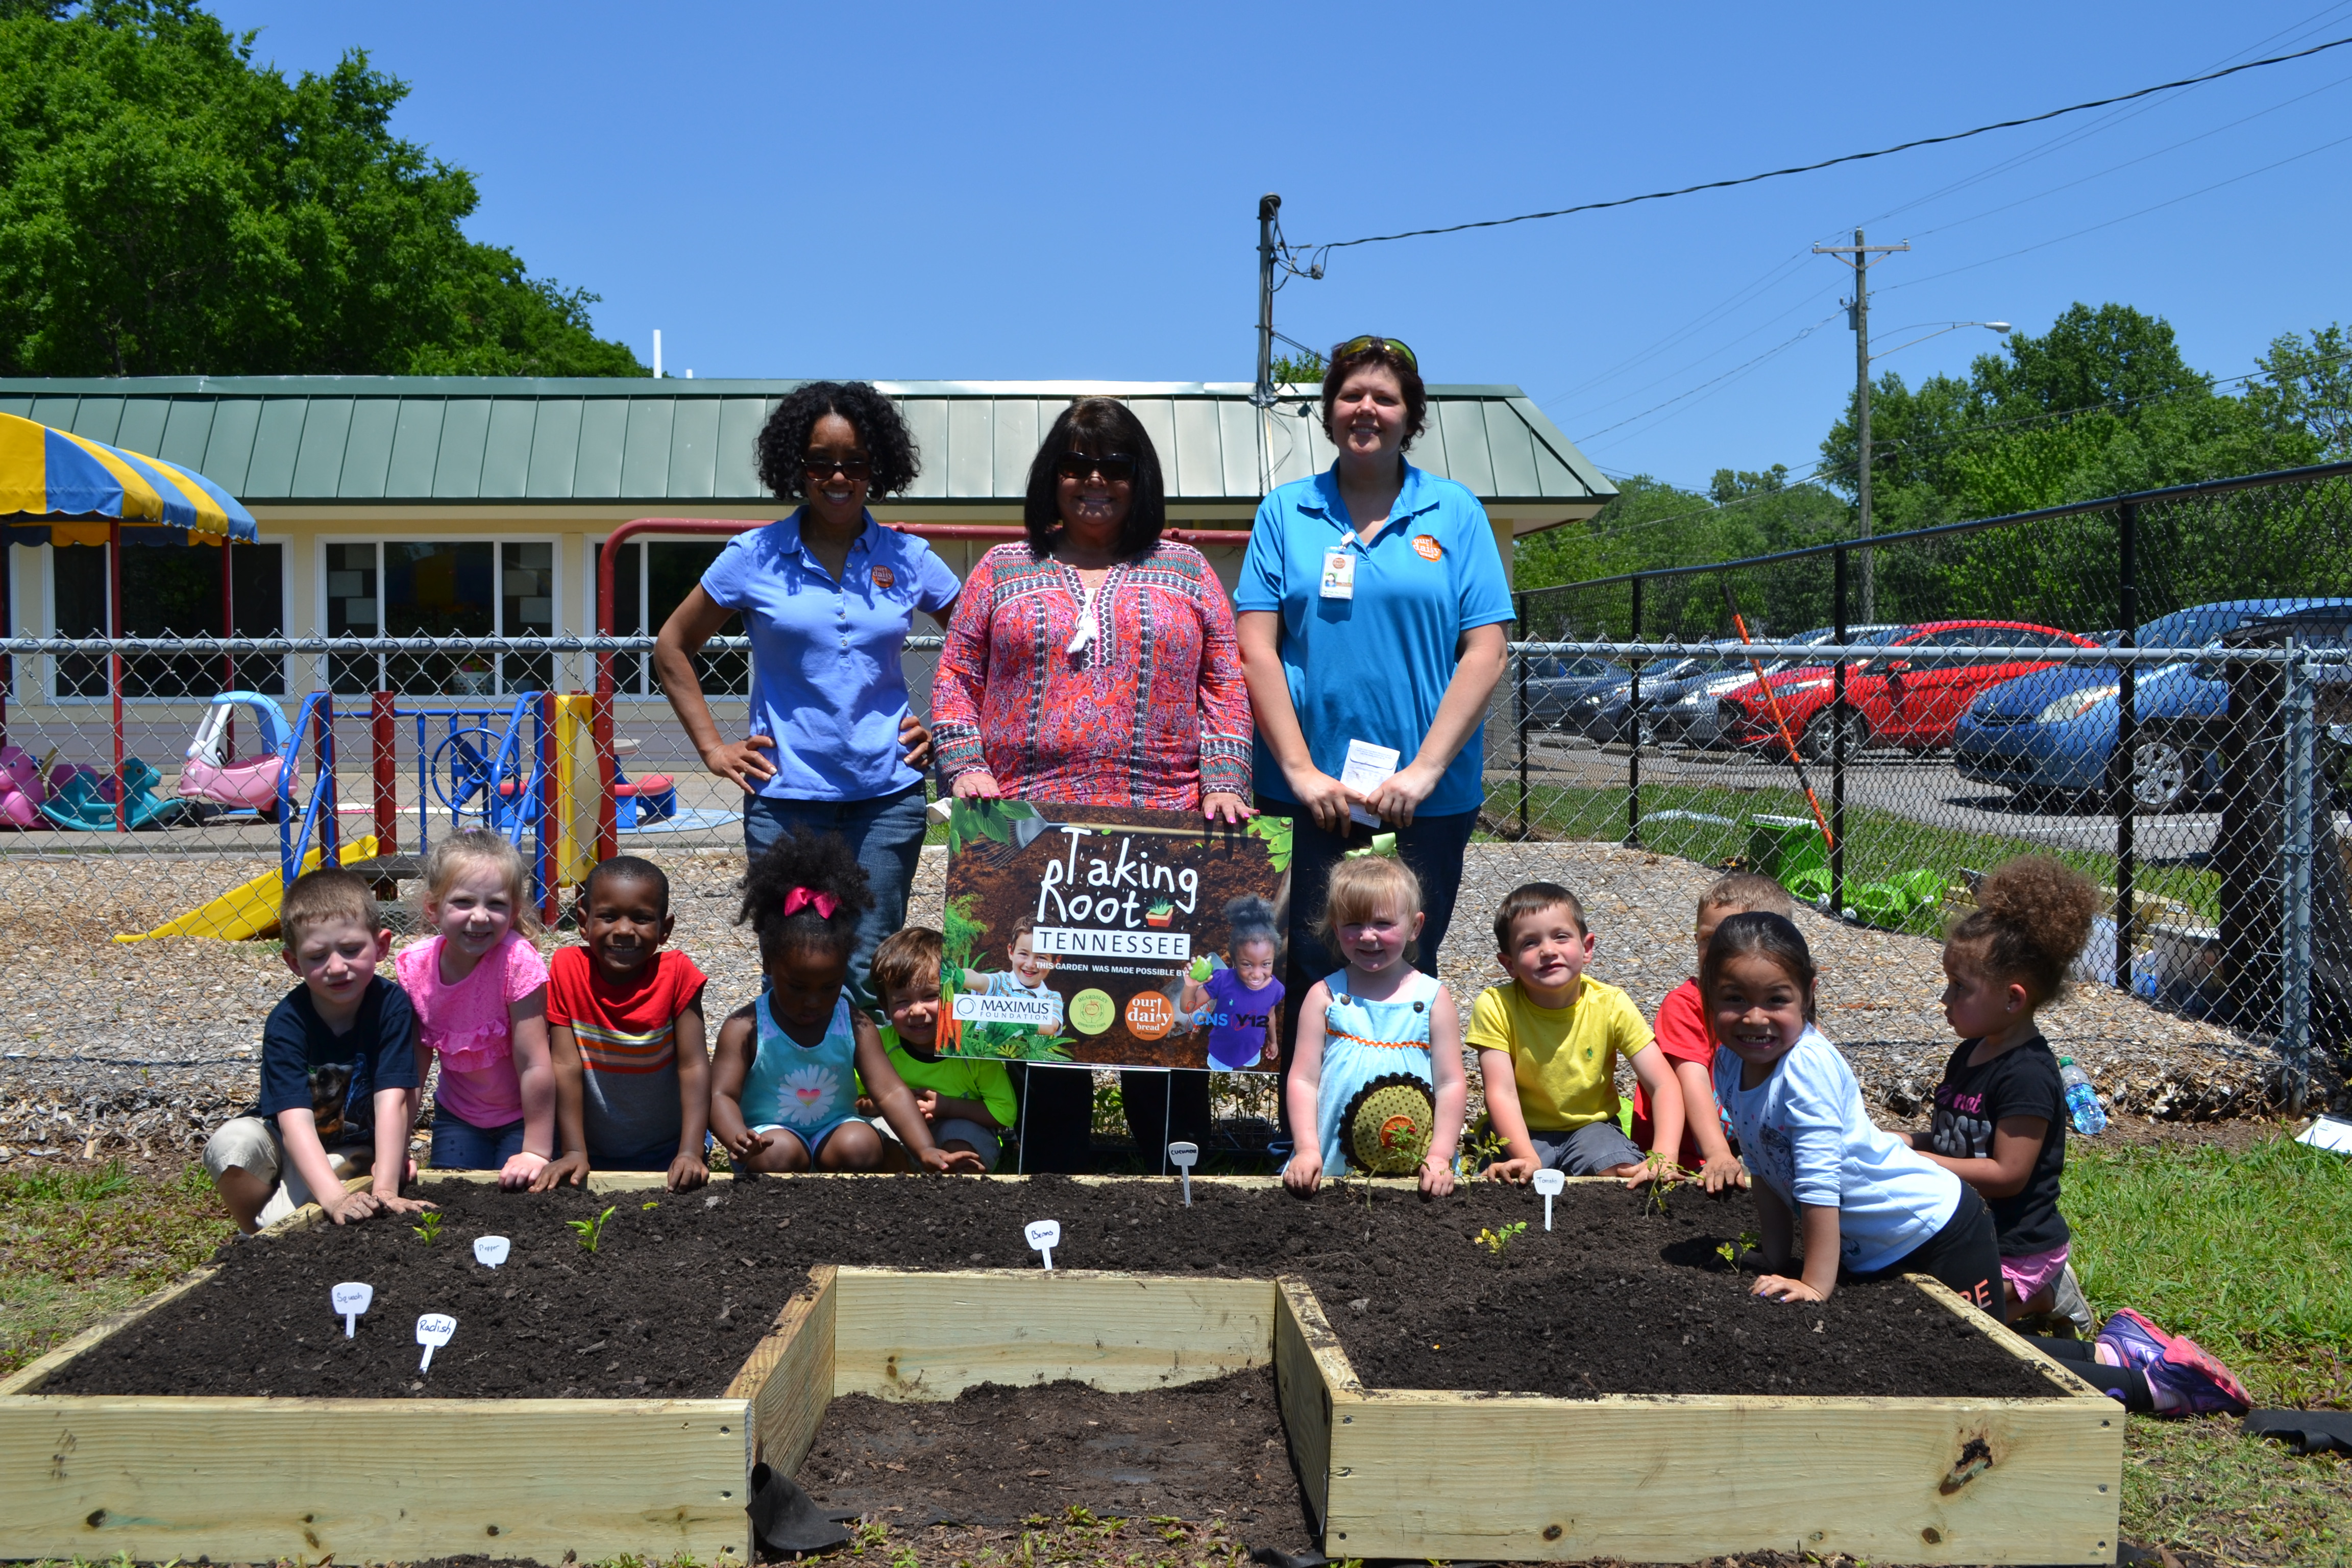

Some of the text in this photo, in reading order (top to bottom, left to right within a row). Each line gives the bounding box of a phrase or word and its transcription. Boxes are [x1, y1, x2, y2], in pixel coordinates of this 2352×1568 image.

[1061, 827, 1198, 914] Taking
[1037, 859, 1141, 928] Root
[1039, 931, 1184, 955] TENNESSEE
[1055, 963, 1088, 971] GARDEN
[1092, 965, 1110, 973] WAS
[1111, 966, 1134, 974] MADE
[1136, 967, 1174, 976] POSSIBLE
[981, 999, 1049, 1014] MAXIMUS
[1077, 995, 1108, 1003] BEARDSLEY
[1132, 998, 1157, 1007] our
[980, 1012, 1047, 1020] FOUNDATION
[1127, 998, 1172, 1026] daily
[1193, 1012, 1269, 1027] CNS Y12
[1136, 1022, 1160, 1031] bread
[1953, 1093, 1982, 1114] not
[1932, 1109, 1992, 1159] SSY
[337, 1292, 363, 1303] Squash
[420, 1319, 451, 1335] Radish
